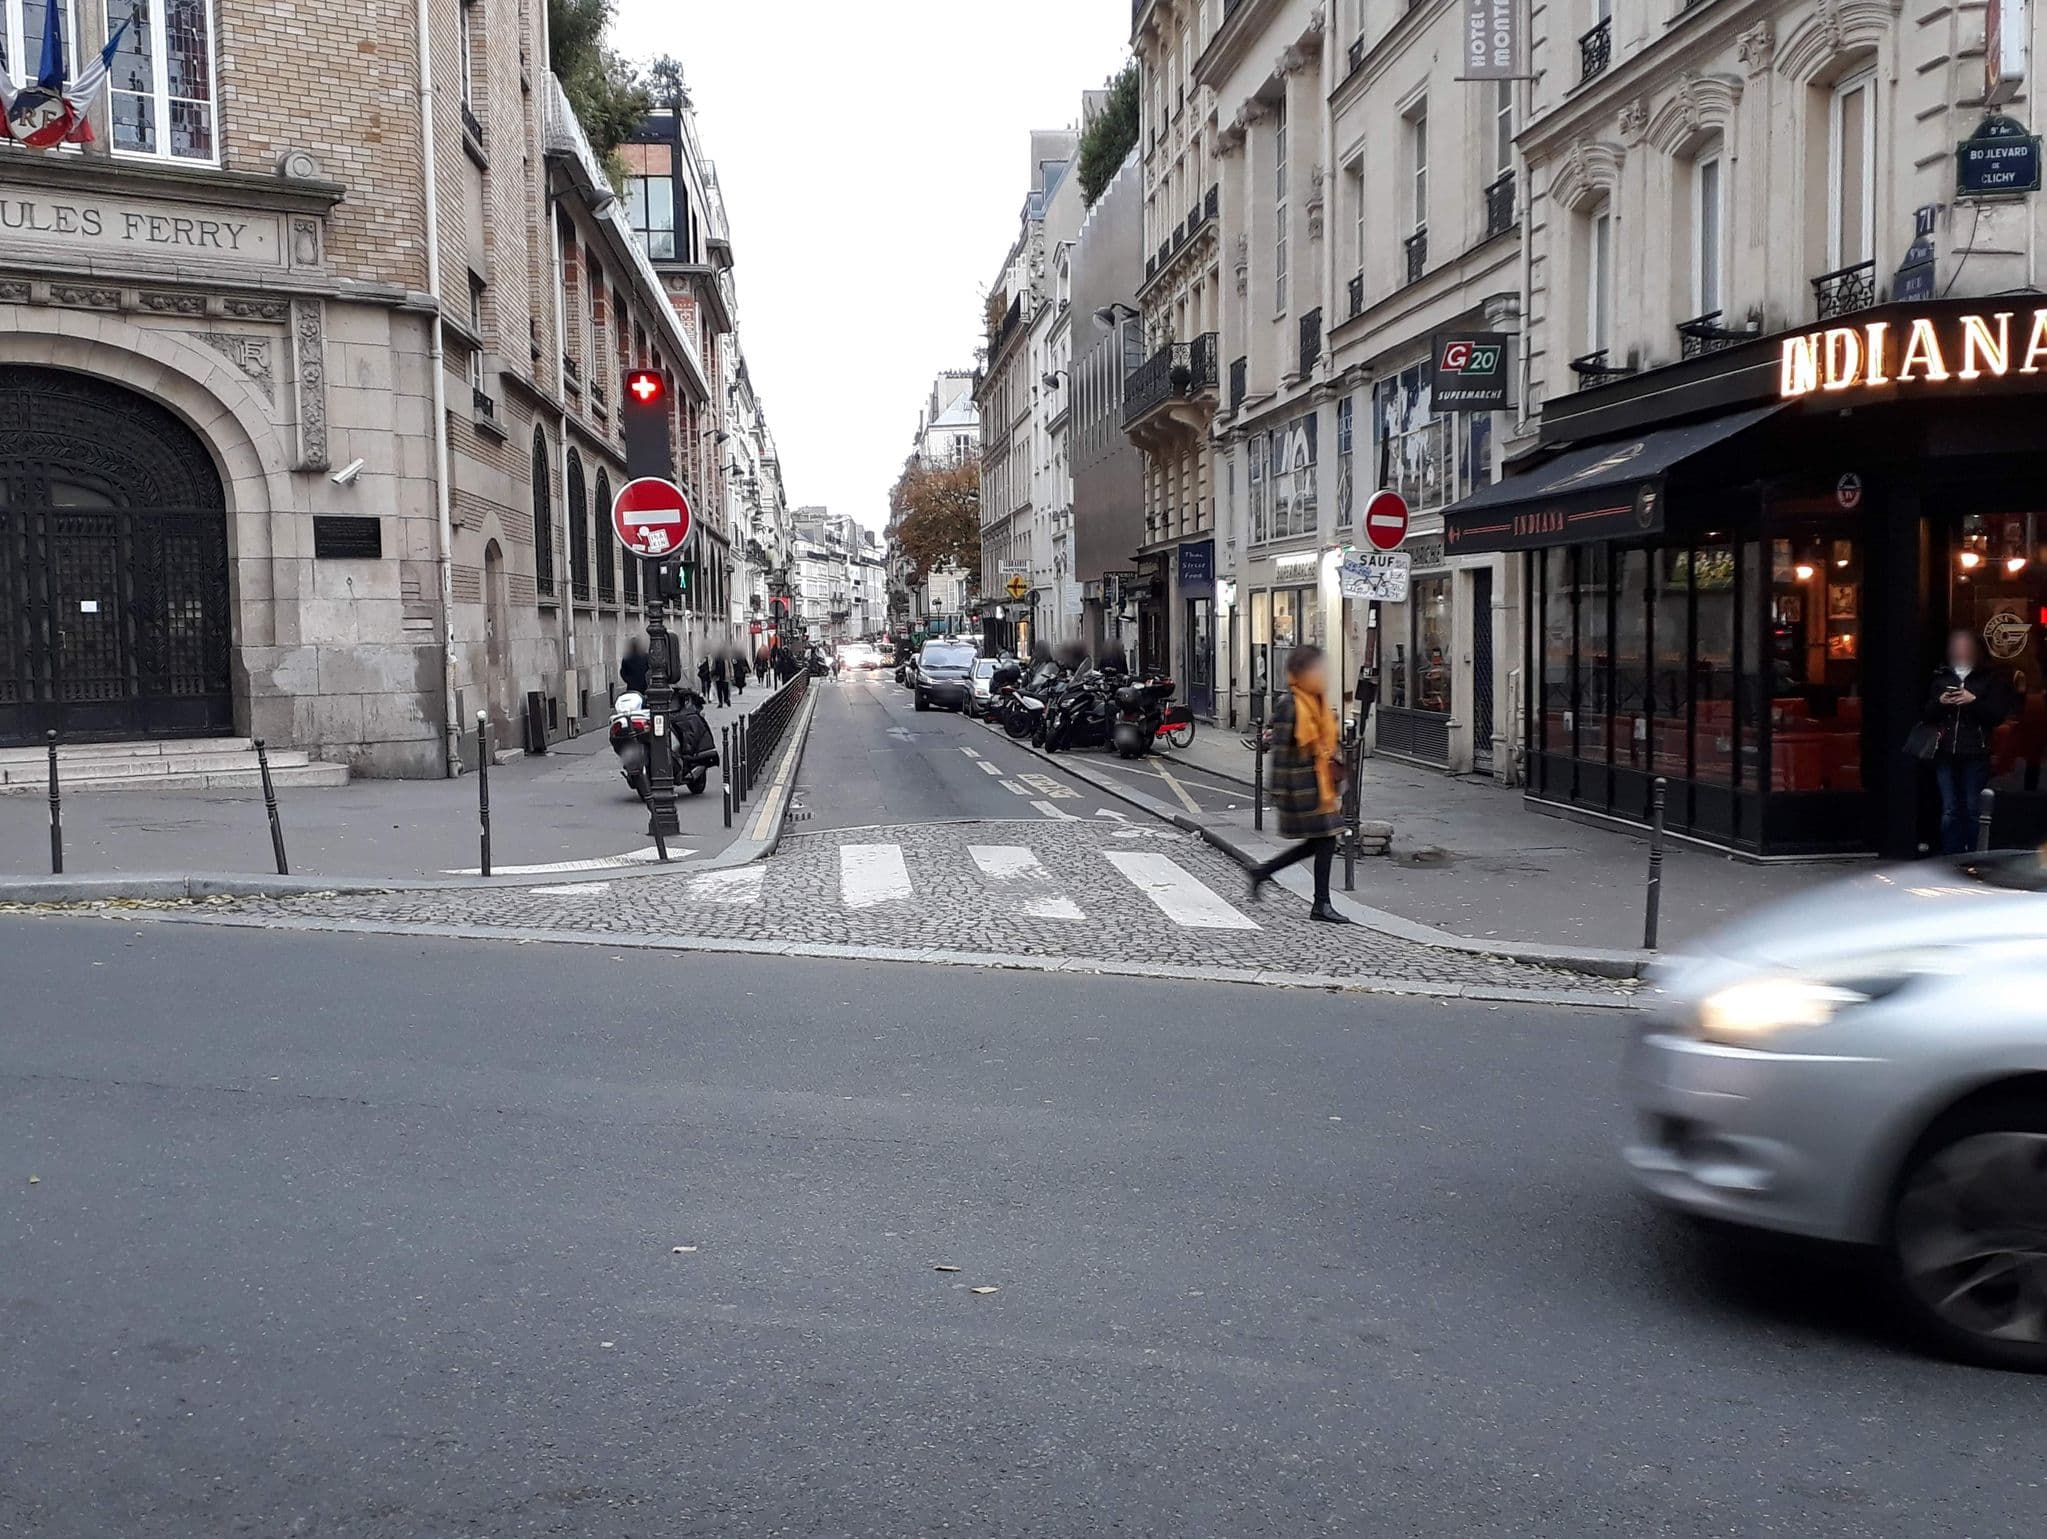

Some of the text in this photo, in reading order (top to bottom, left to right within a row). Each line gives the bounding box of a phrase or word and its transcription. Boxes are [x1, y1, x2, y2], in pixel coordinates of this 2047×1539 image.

[1471, 12, 1486, 66] HOTEL
[1981, 172, 2015, 184] CLICHY
[120, 212, 248, 250] FERRY
[1919, 207, 1931, 233] 71
[1447, 345, 1495, 369] G20
[1513, 511, 1565, 536] INDIANA
[1359, 554, 1396, 567] SAUF
